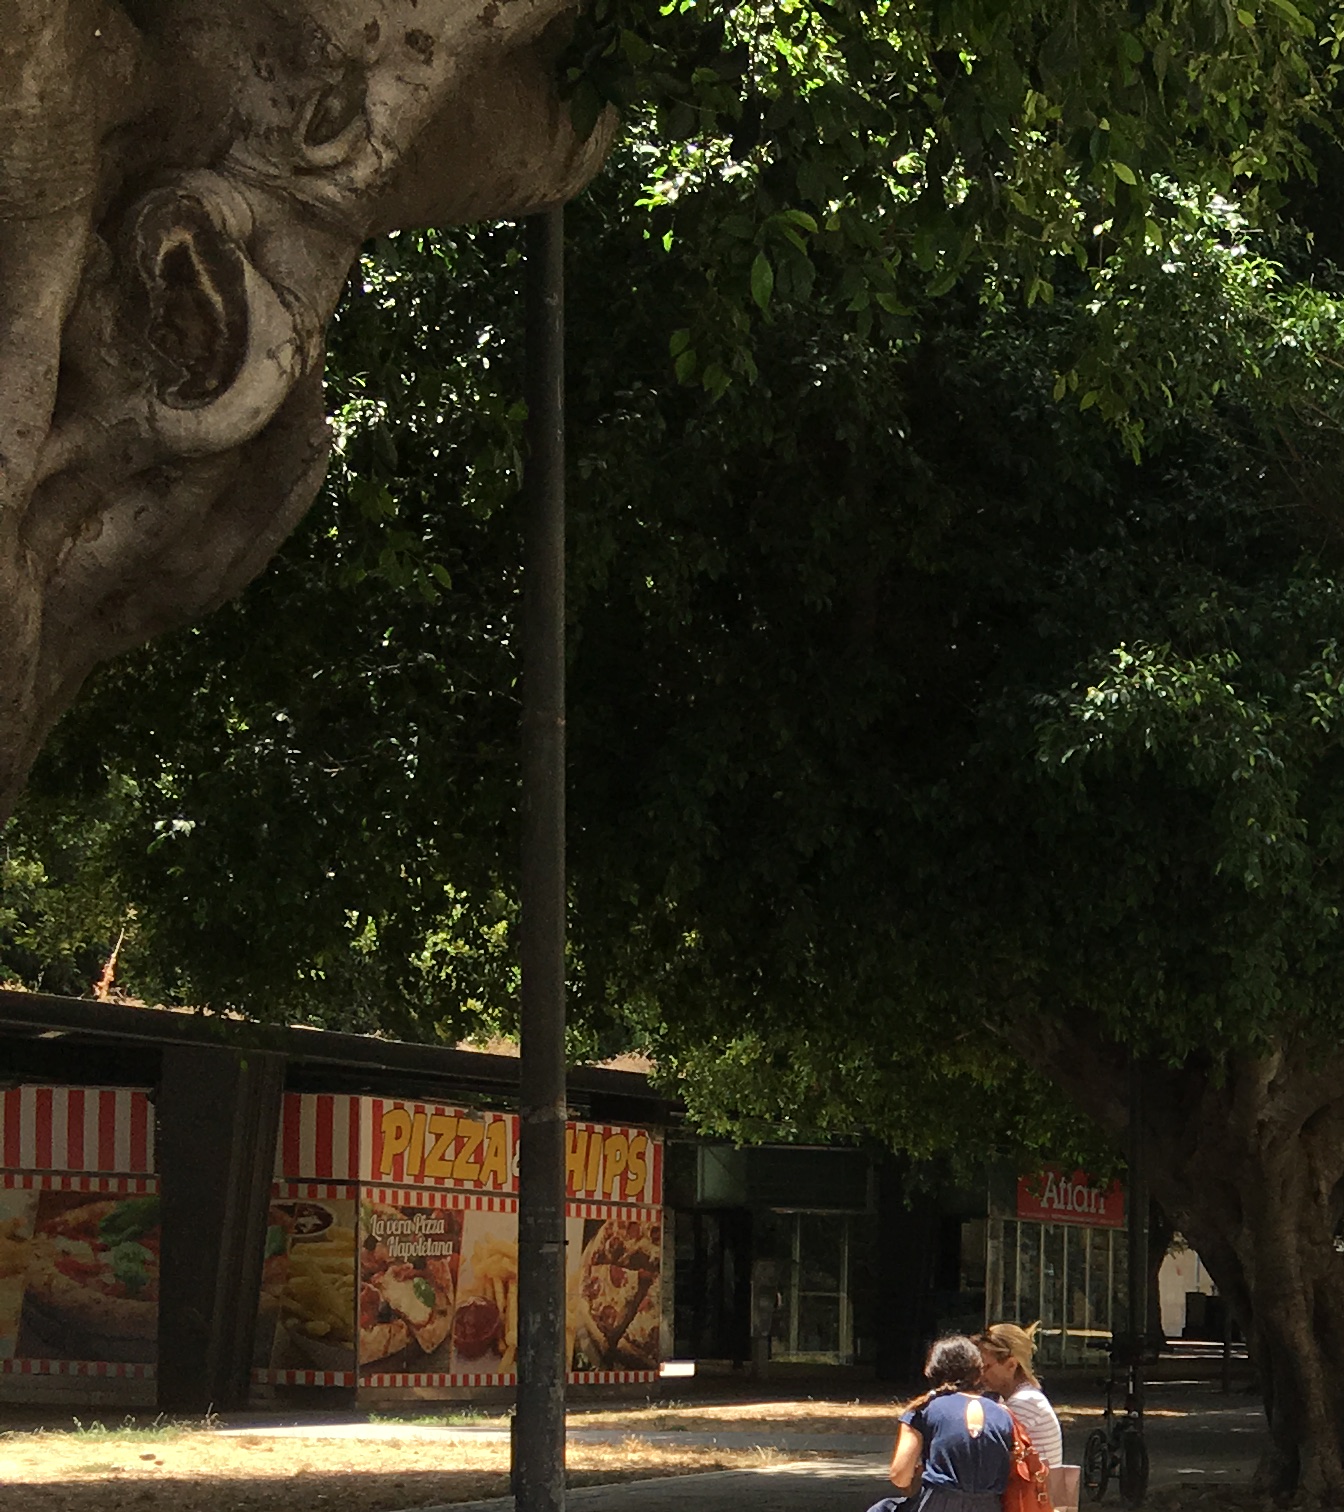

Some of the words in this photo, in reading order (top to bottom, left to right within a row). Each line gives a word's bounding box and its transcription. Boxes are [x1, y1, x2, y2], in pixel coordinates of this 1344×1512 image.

[380, 1107, 507, 1186] PIZZA
[565, 1129, 649, 1197] HIPS
[370, 1214, 384, 1241] La
[386, 1219, 413, 1235] vera
[413, 1213, 445, 1234] Pizza
[387, 1233, 453, 1262] Napoletana
